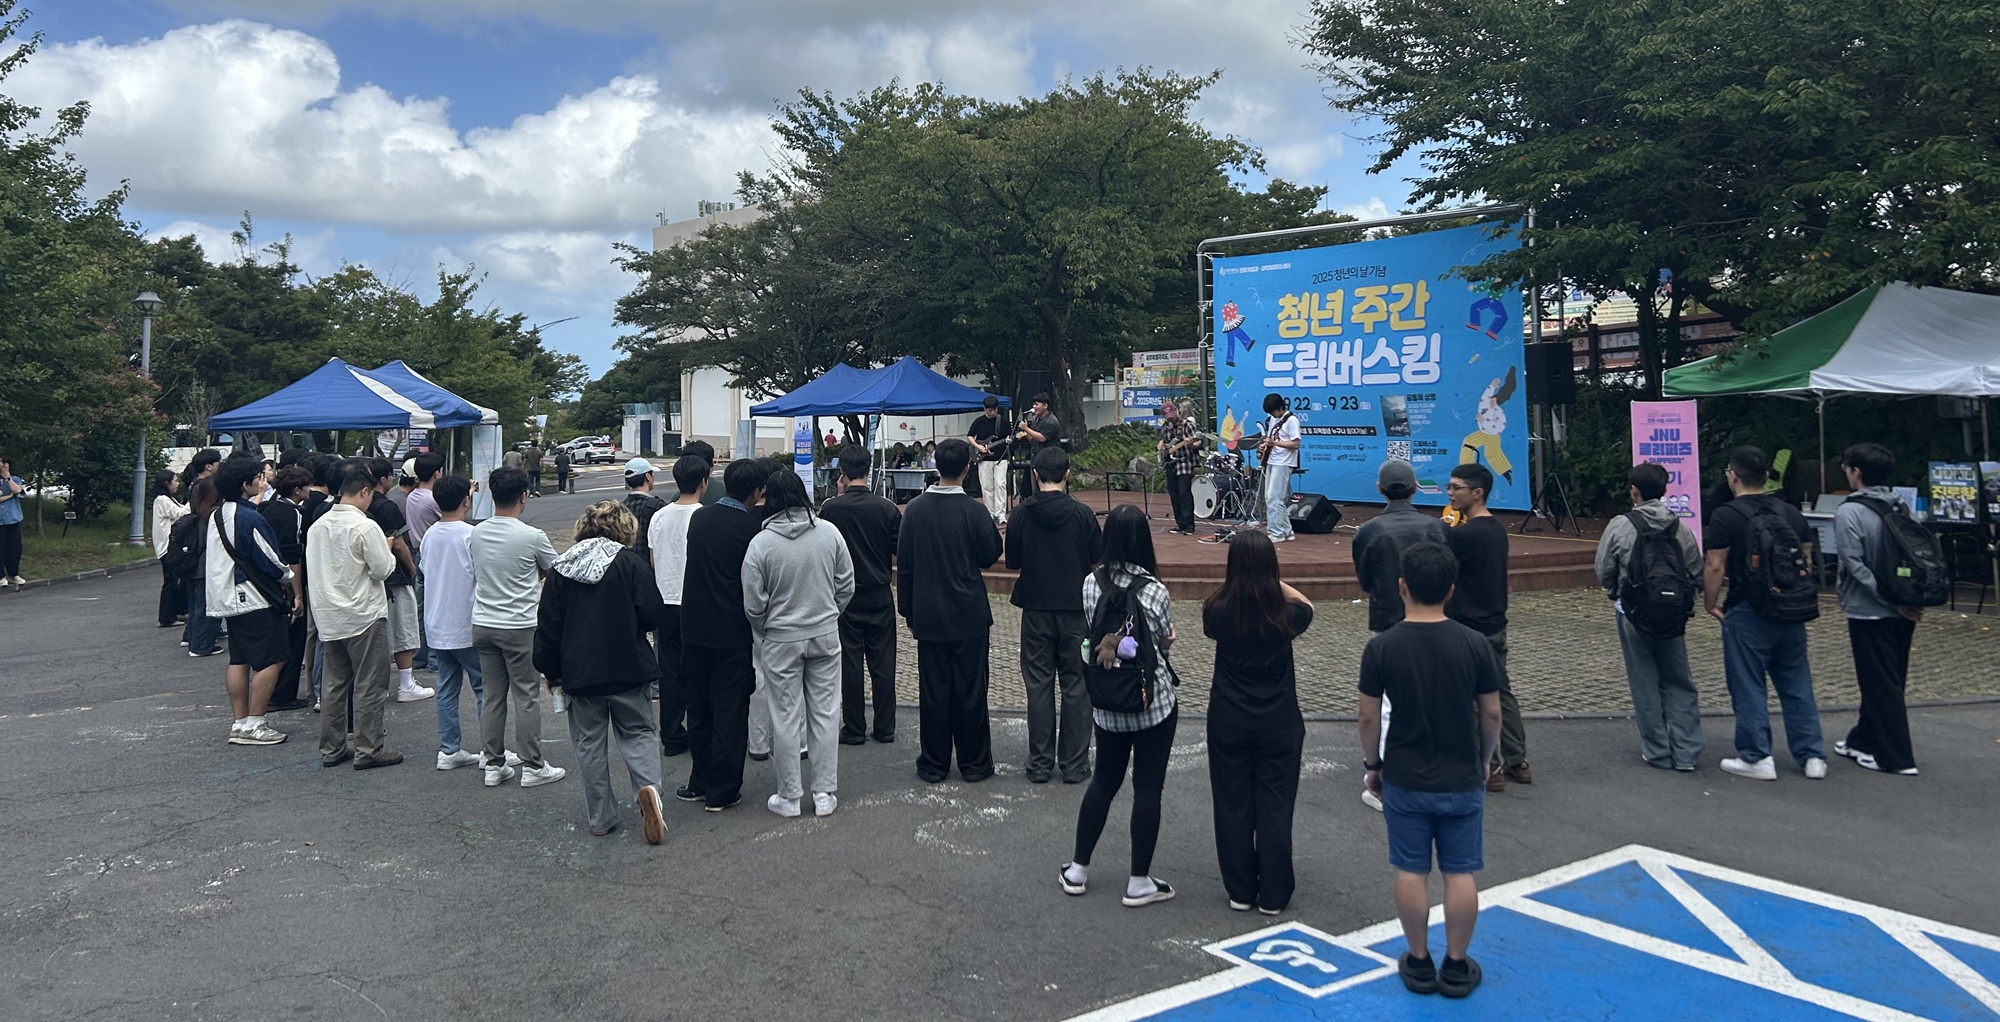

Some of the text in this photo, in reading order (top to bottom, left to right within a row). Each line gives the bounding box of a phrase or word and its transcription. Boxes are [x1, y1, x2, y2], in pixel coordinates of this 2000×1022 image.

[1312, 270, 1334, 285] 2025
[1277, 279, 1431, 339] 청년 주간
[1262, 332, 1442, 388] 드림버스킹
[1649, 428, 1680, 442] JNU
[1639, 442, 1692, 456] 클리퍼즈
[1667, 470, 1682, 485] 기
